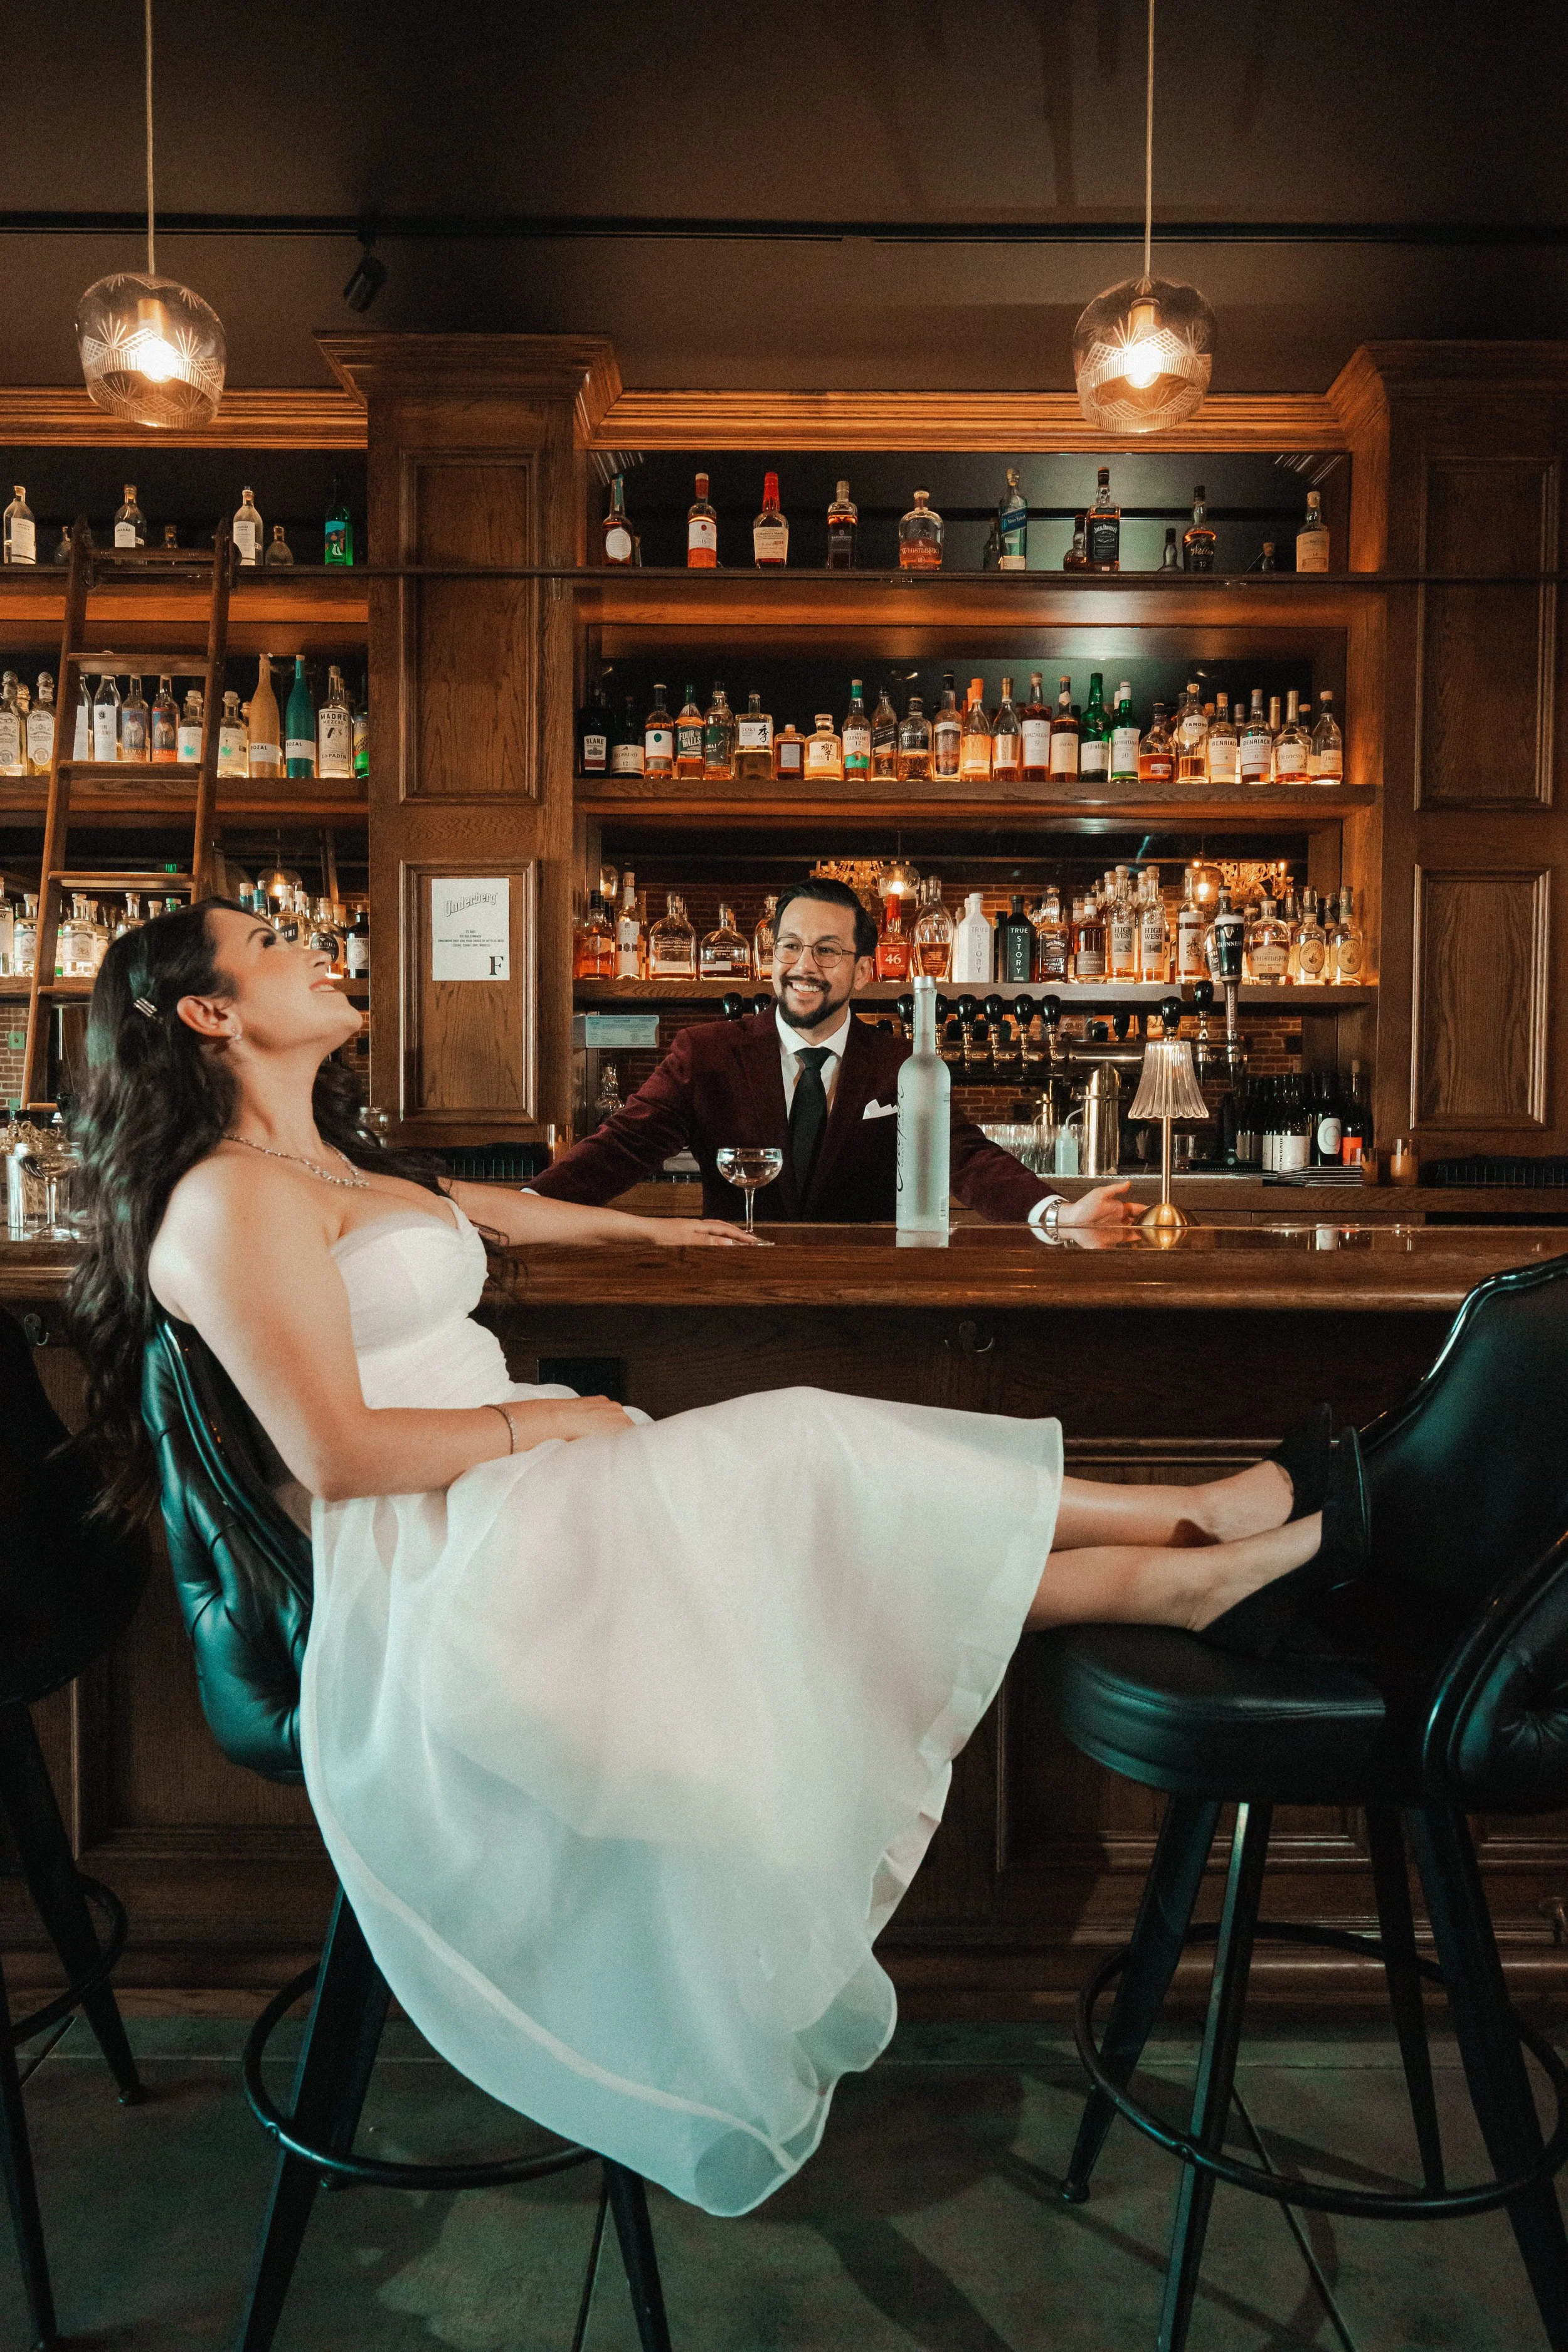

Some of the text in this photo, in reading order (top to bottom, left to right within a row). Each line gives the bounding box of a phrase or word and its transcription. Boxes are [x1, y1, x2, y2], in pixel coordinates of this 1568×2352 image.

[1094, 526, 1103, 534] JACK
[1190, 543, 1214, 556] Weller
[679, 729, 695, 741] FOUR
[682, 736, 702, 748] WALLS
[444, 892, 497, 917] Underberg
[884, 953, 902, 965] 46
[489, 956, 504, 975] F
